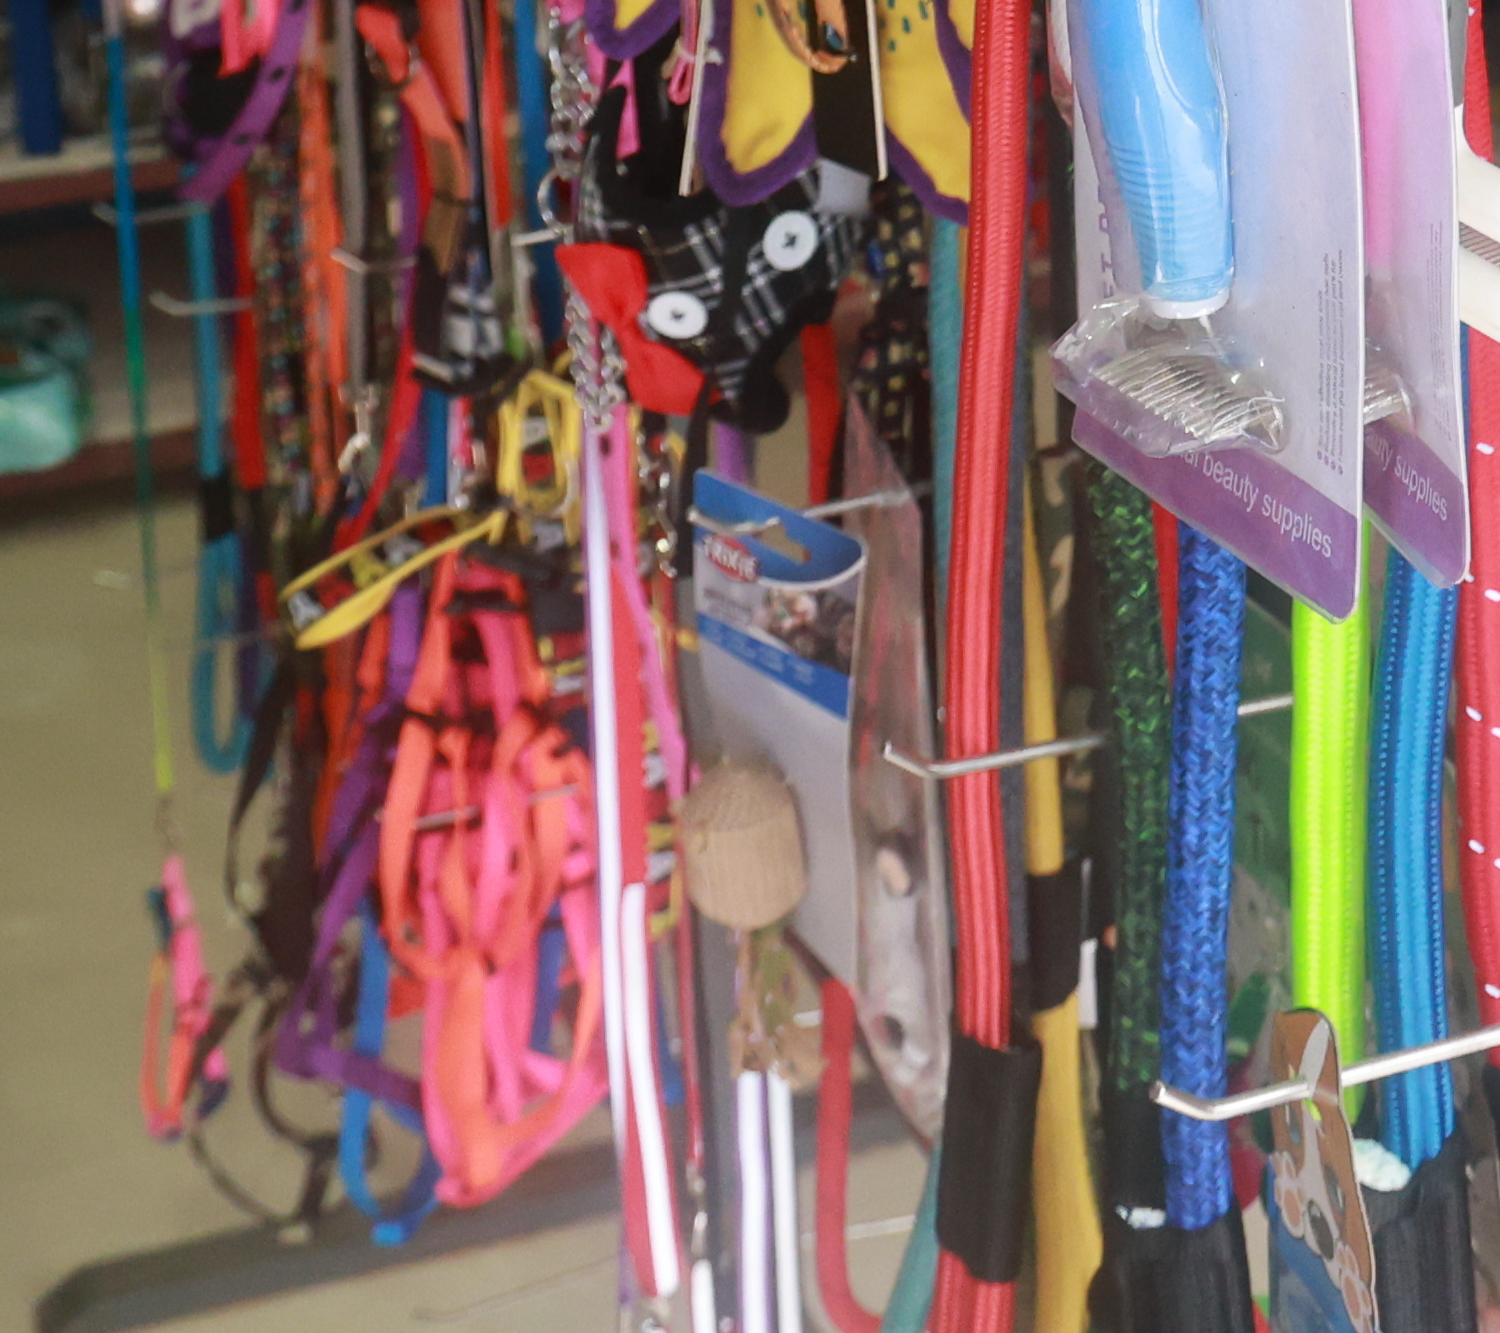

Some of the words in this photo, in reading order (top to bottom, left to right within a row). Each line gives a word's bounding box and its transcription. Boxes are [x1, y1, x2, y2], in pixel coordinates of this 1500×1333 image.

[1202, 452, 1260, 513] beauty
[1261, 492, 1333, 559] supplies
[1393, 457, 1448, 522] supplies
